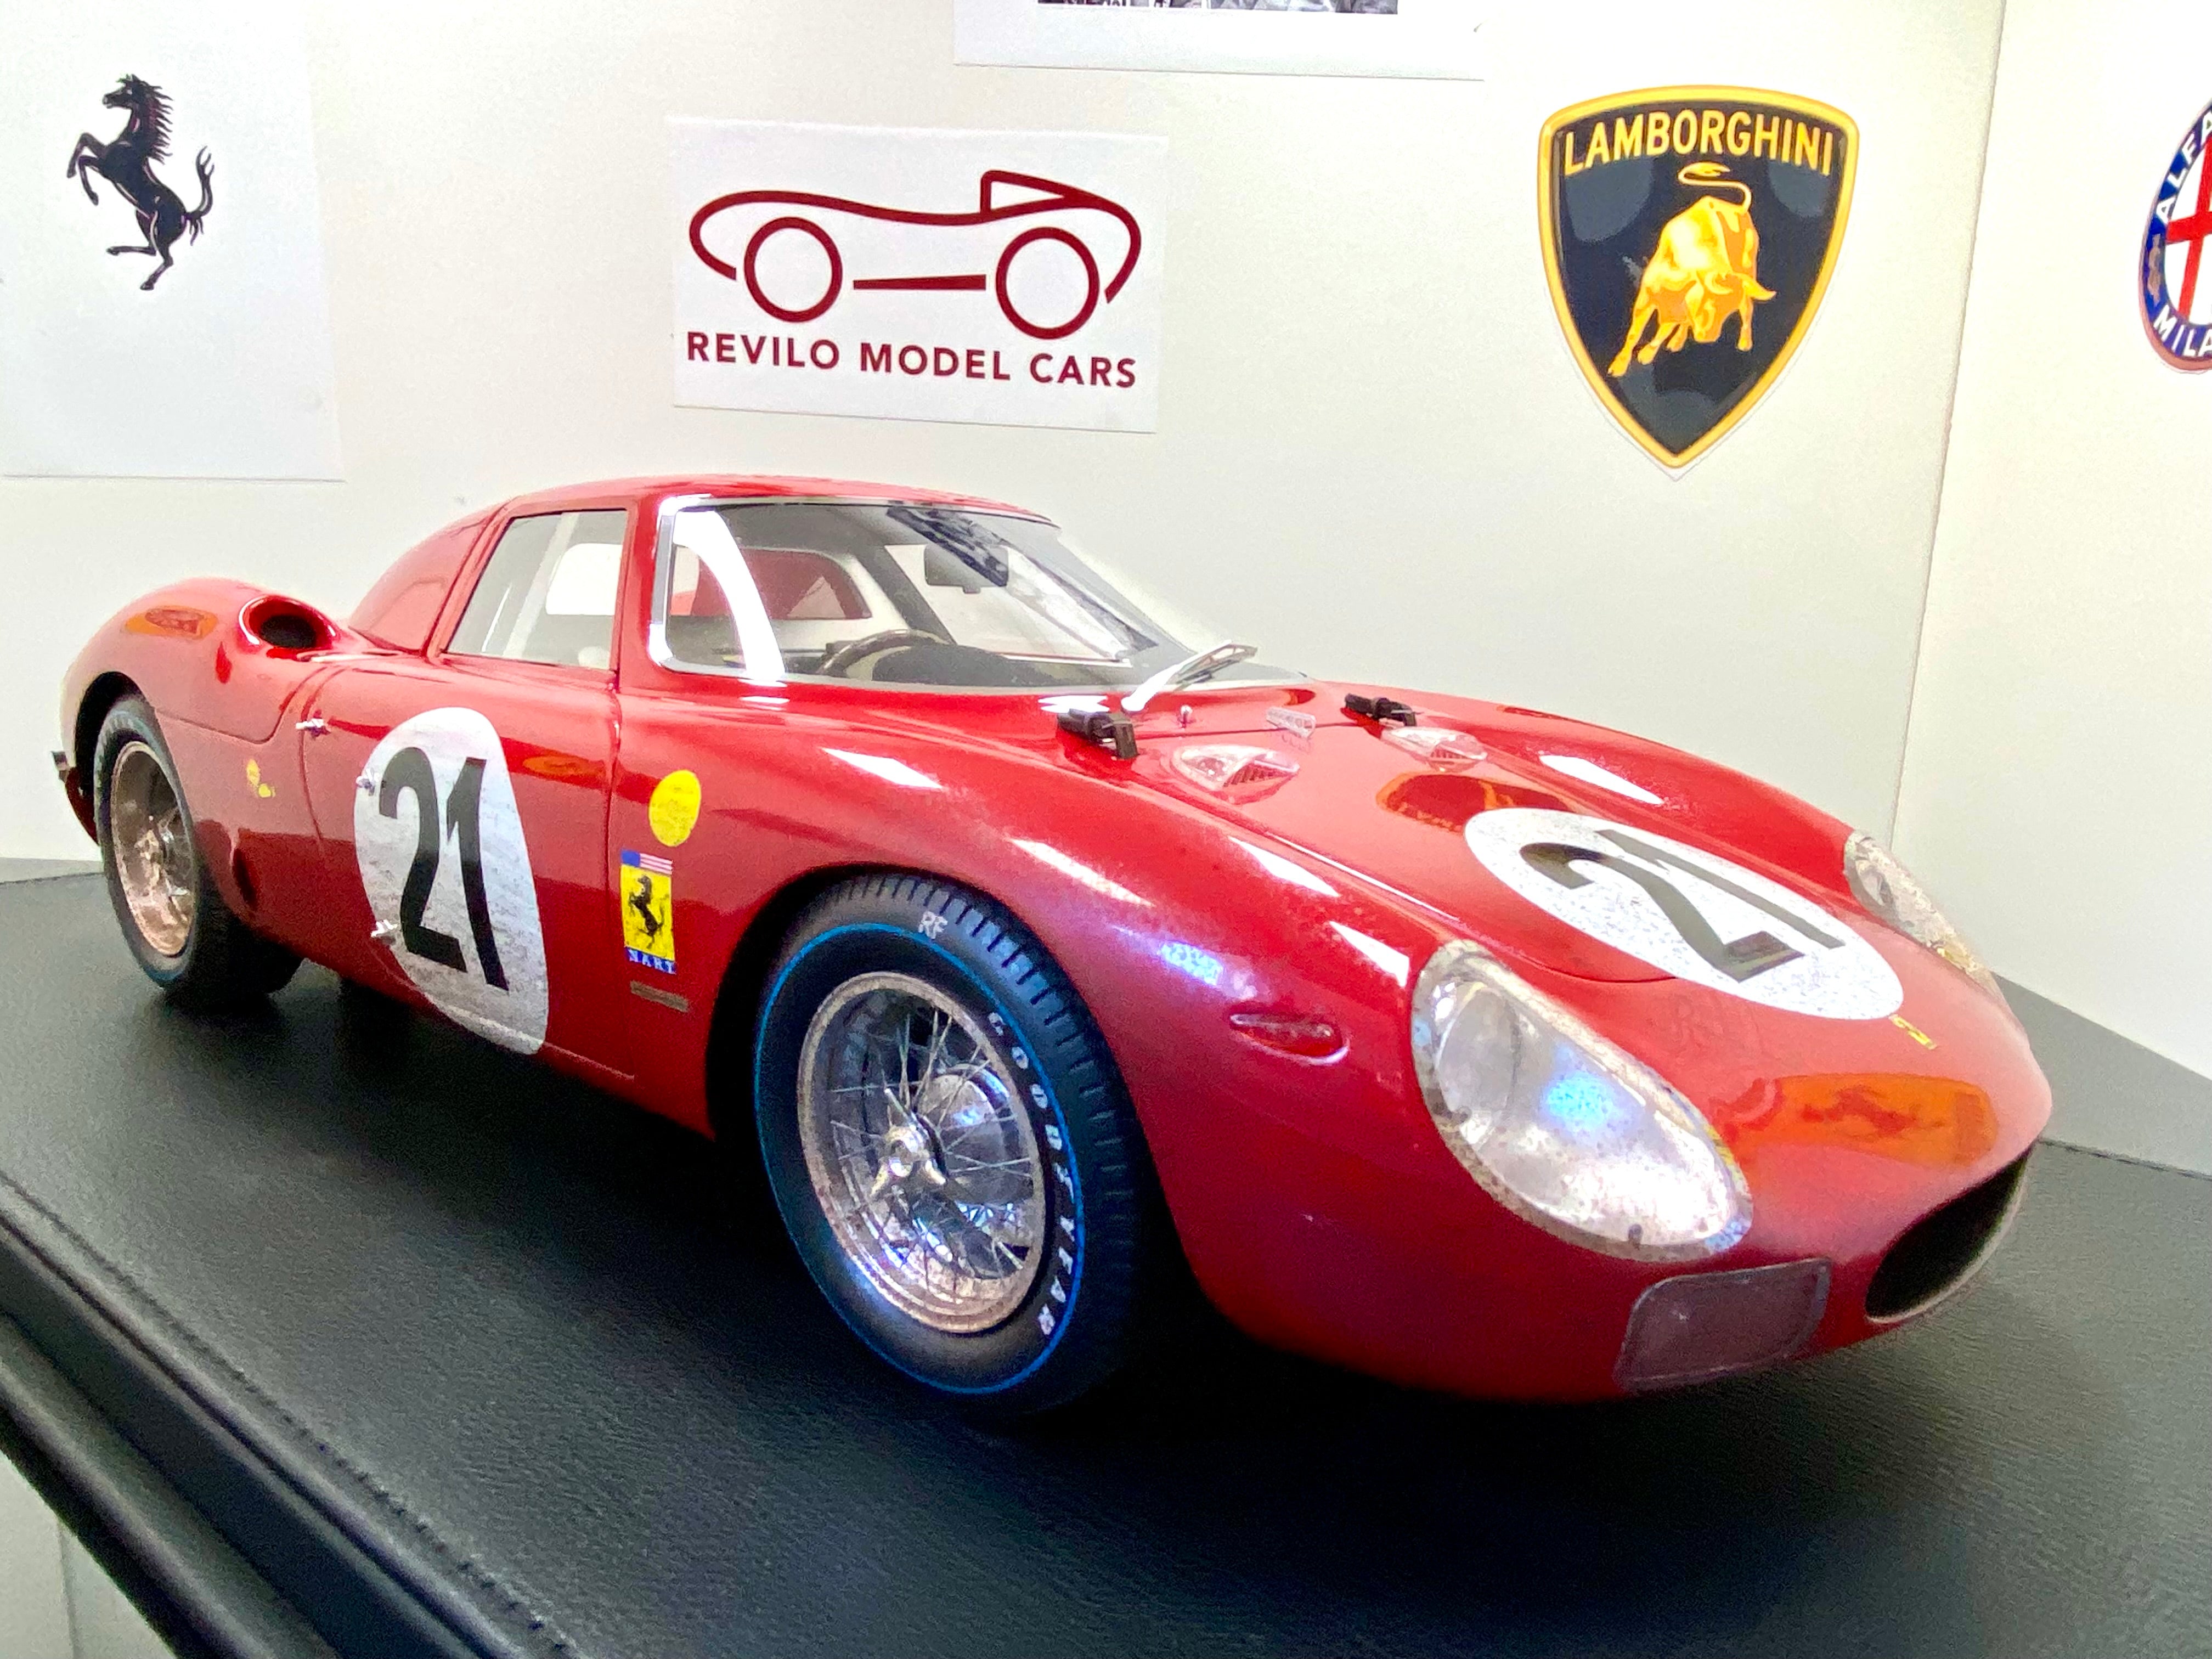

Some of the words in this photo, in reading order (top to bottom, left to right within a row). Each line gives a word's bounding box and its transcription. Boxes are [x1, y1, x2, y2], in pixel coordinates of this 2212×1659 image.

[1564, 109, 1833, 177] LAMBORGHINI
[687, 331, 840, 370] REVILO
[860, 342, 1011, 381] MODEL
[1029, 353, 1137, 389] CARS
[379, 746, 509, 991] 21
[918, 911, 948, 939] RF
[1519, 828, 1846, 983] 21
